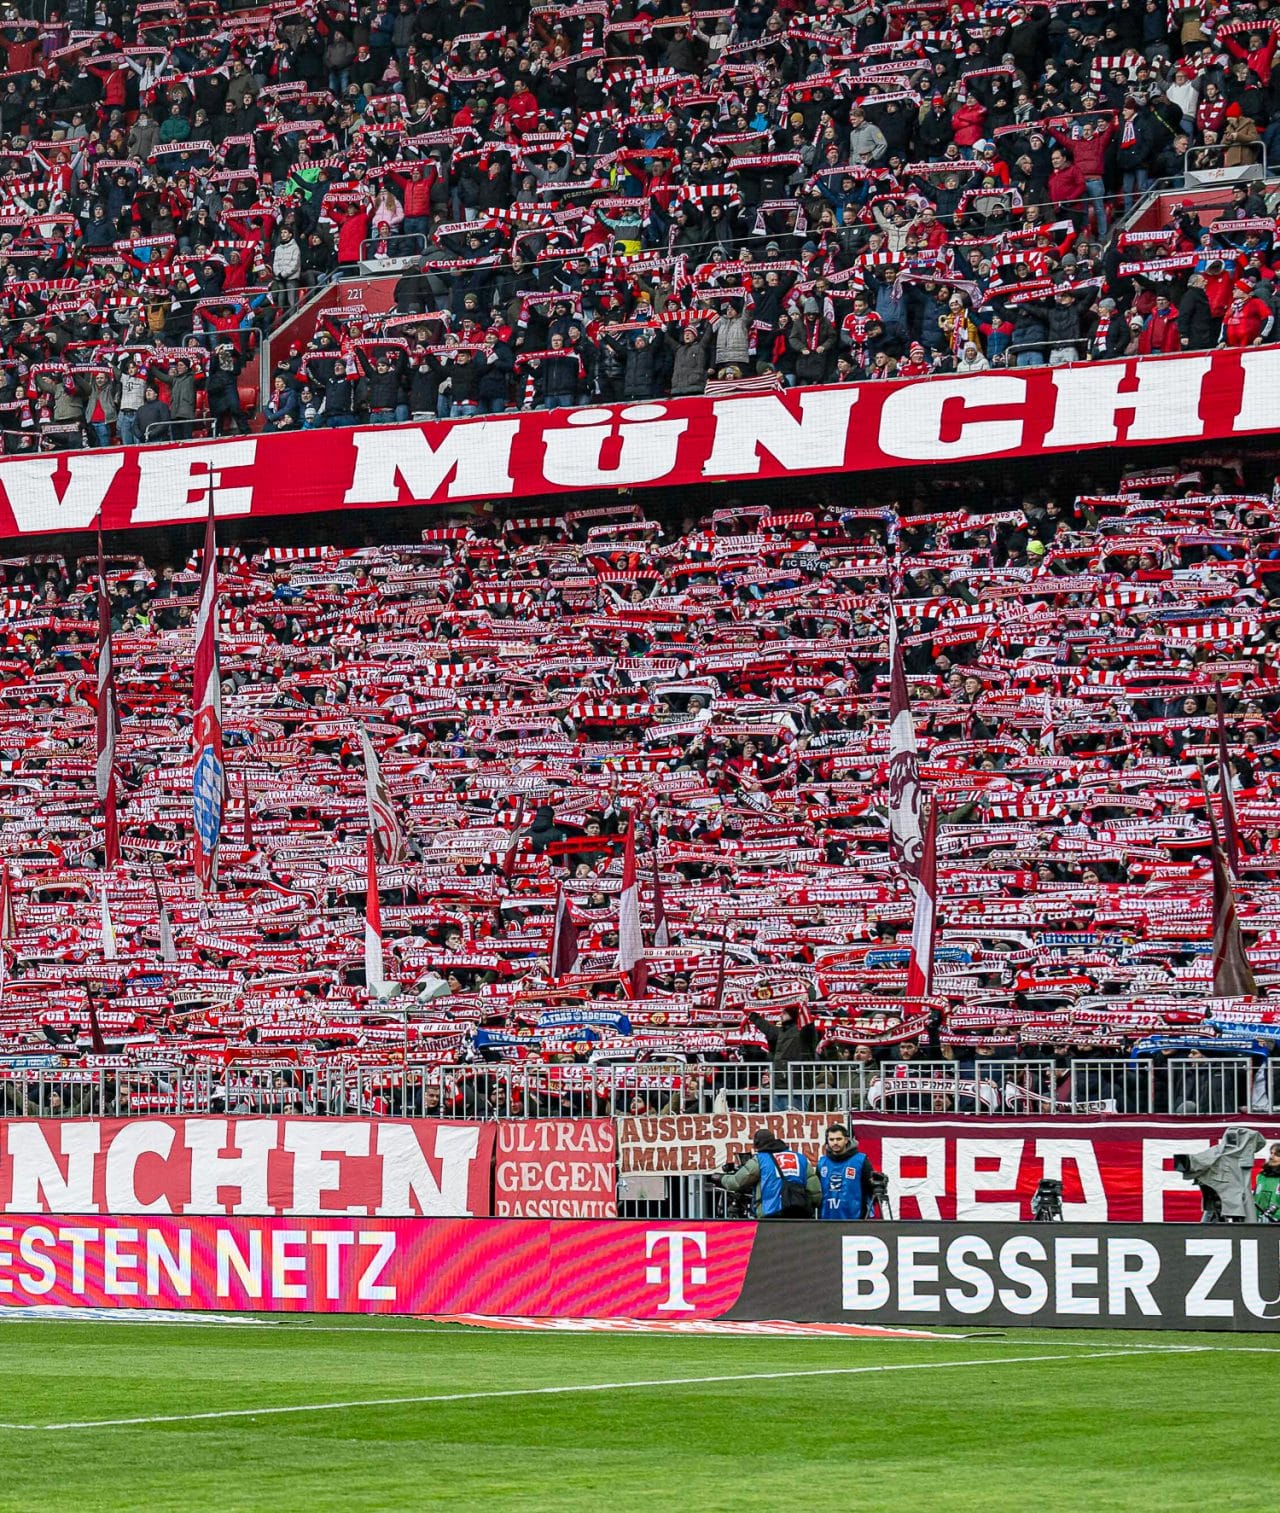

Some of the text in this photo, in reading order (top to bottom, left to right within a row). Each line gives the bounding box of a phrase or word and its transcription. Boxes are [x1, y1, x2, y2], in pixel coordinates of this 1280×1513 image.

[346, 290, 363, 300] 221
[344, 343, 1280, 506] MÜNCH
[498, 1120, 614, 1153] ULTRAS
[621, 1144, 716, 1174] IMMER
[497, 1160, 614, 1193] GEGEN
[216, 1229, 397, 1300] NETZ
[842, 1236, 1161, 1316] BESSER
